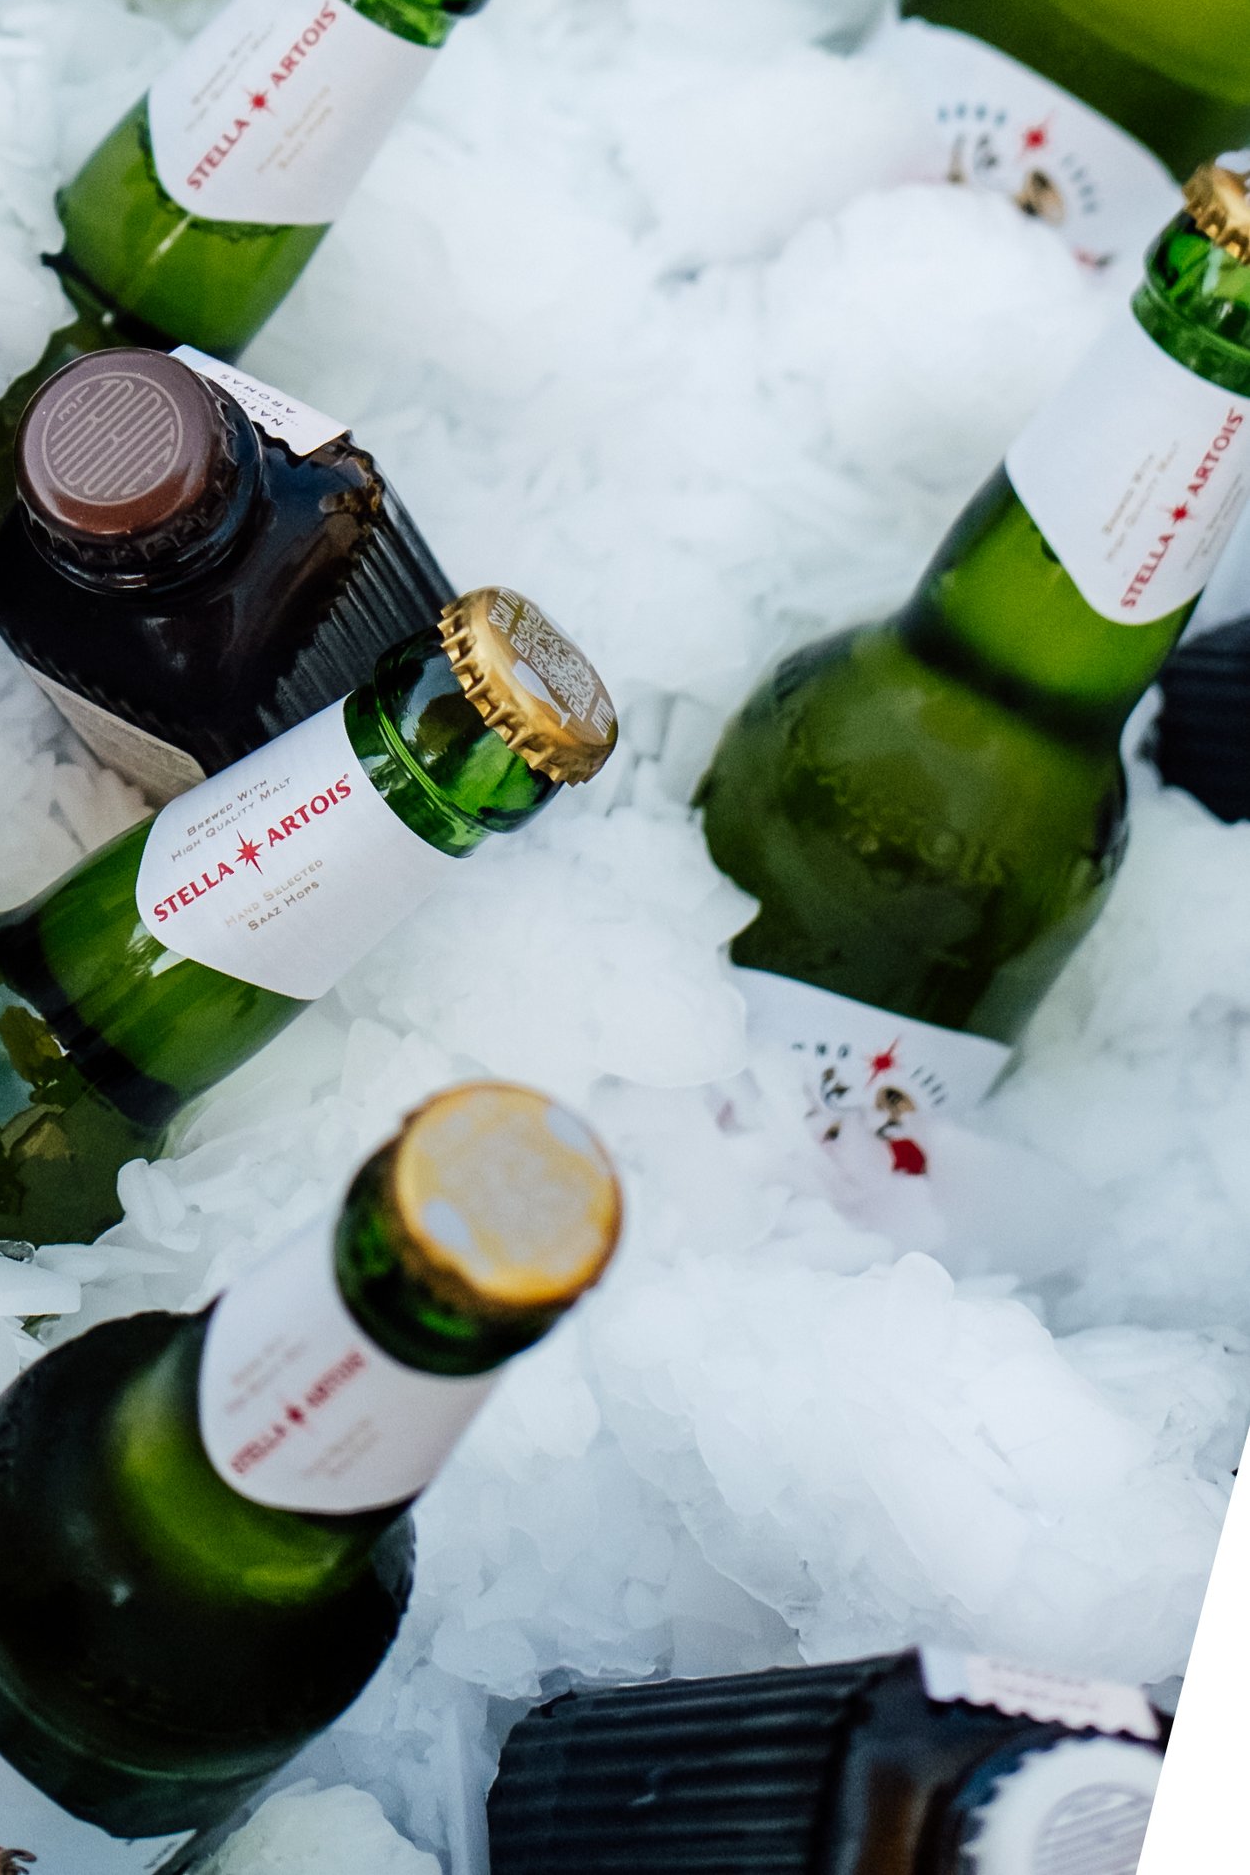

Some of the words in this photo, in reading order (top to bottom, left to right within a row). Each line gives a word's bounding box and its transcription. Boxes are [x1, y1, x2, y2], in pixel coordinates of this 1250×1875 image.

[186, 117, 250, 191] STELLA
[270, 6, 337, 89] ARTOIS
[57, 386, 90, 422] EL
[219, 373, 297, 415] AROMAS
[237, 397, 283, 427] NATU
[1120, 531, 1175, 610] STELLA
[1187, 411, 1244, 499] ARTOIS
[170, 838, 202, 863] HIGH
[205, 801, 256, 838] QUALITY
[259, 776, 292, 801] MALT
[186, 802, 234, 837] BREWED
[236, 778, 268, 802] WITH
[152, 861, 235, 923] STELLA
[267, 777, 353, 849] ARTOIS
[224, 901, 260, 929] HAND
[262, 858, 324, 903] SELECTED
[247, 907, 282, 932] SAAZ
[286, 879, 321, 907] HOPS
